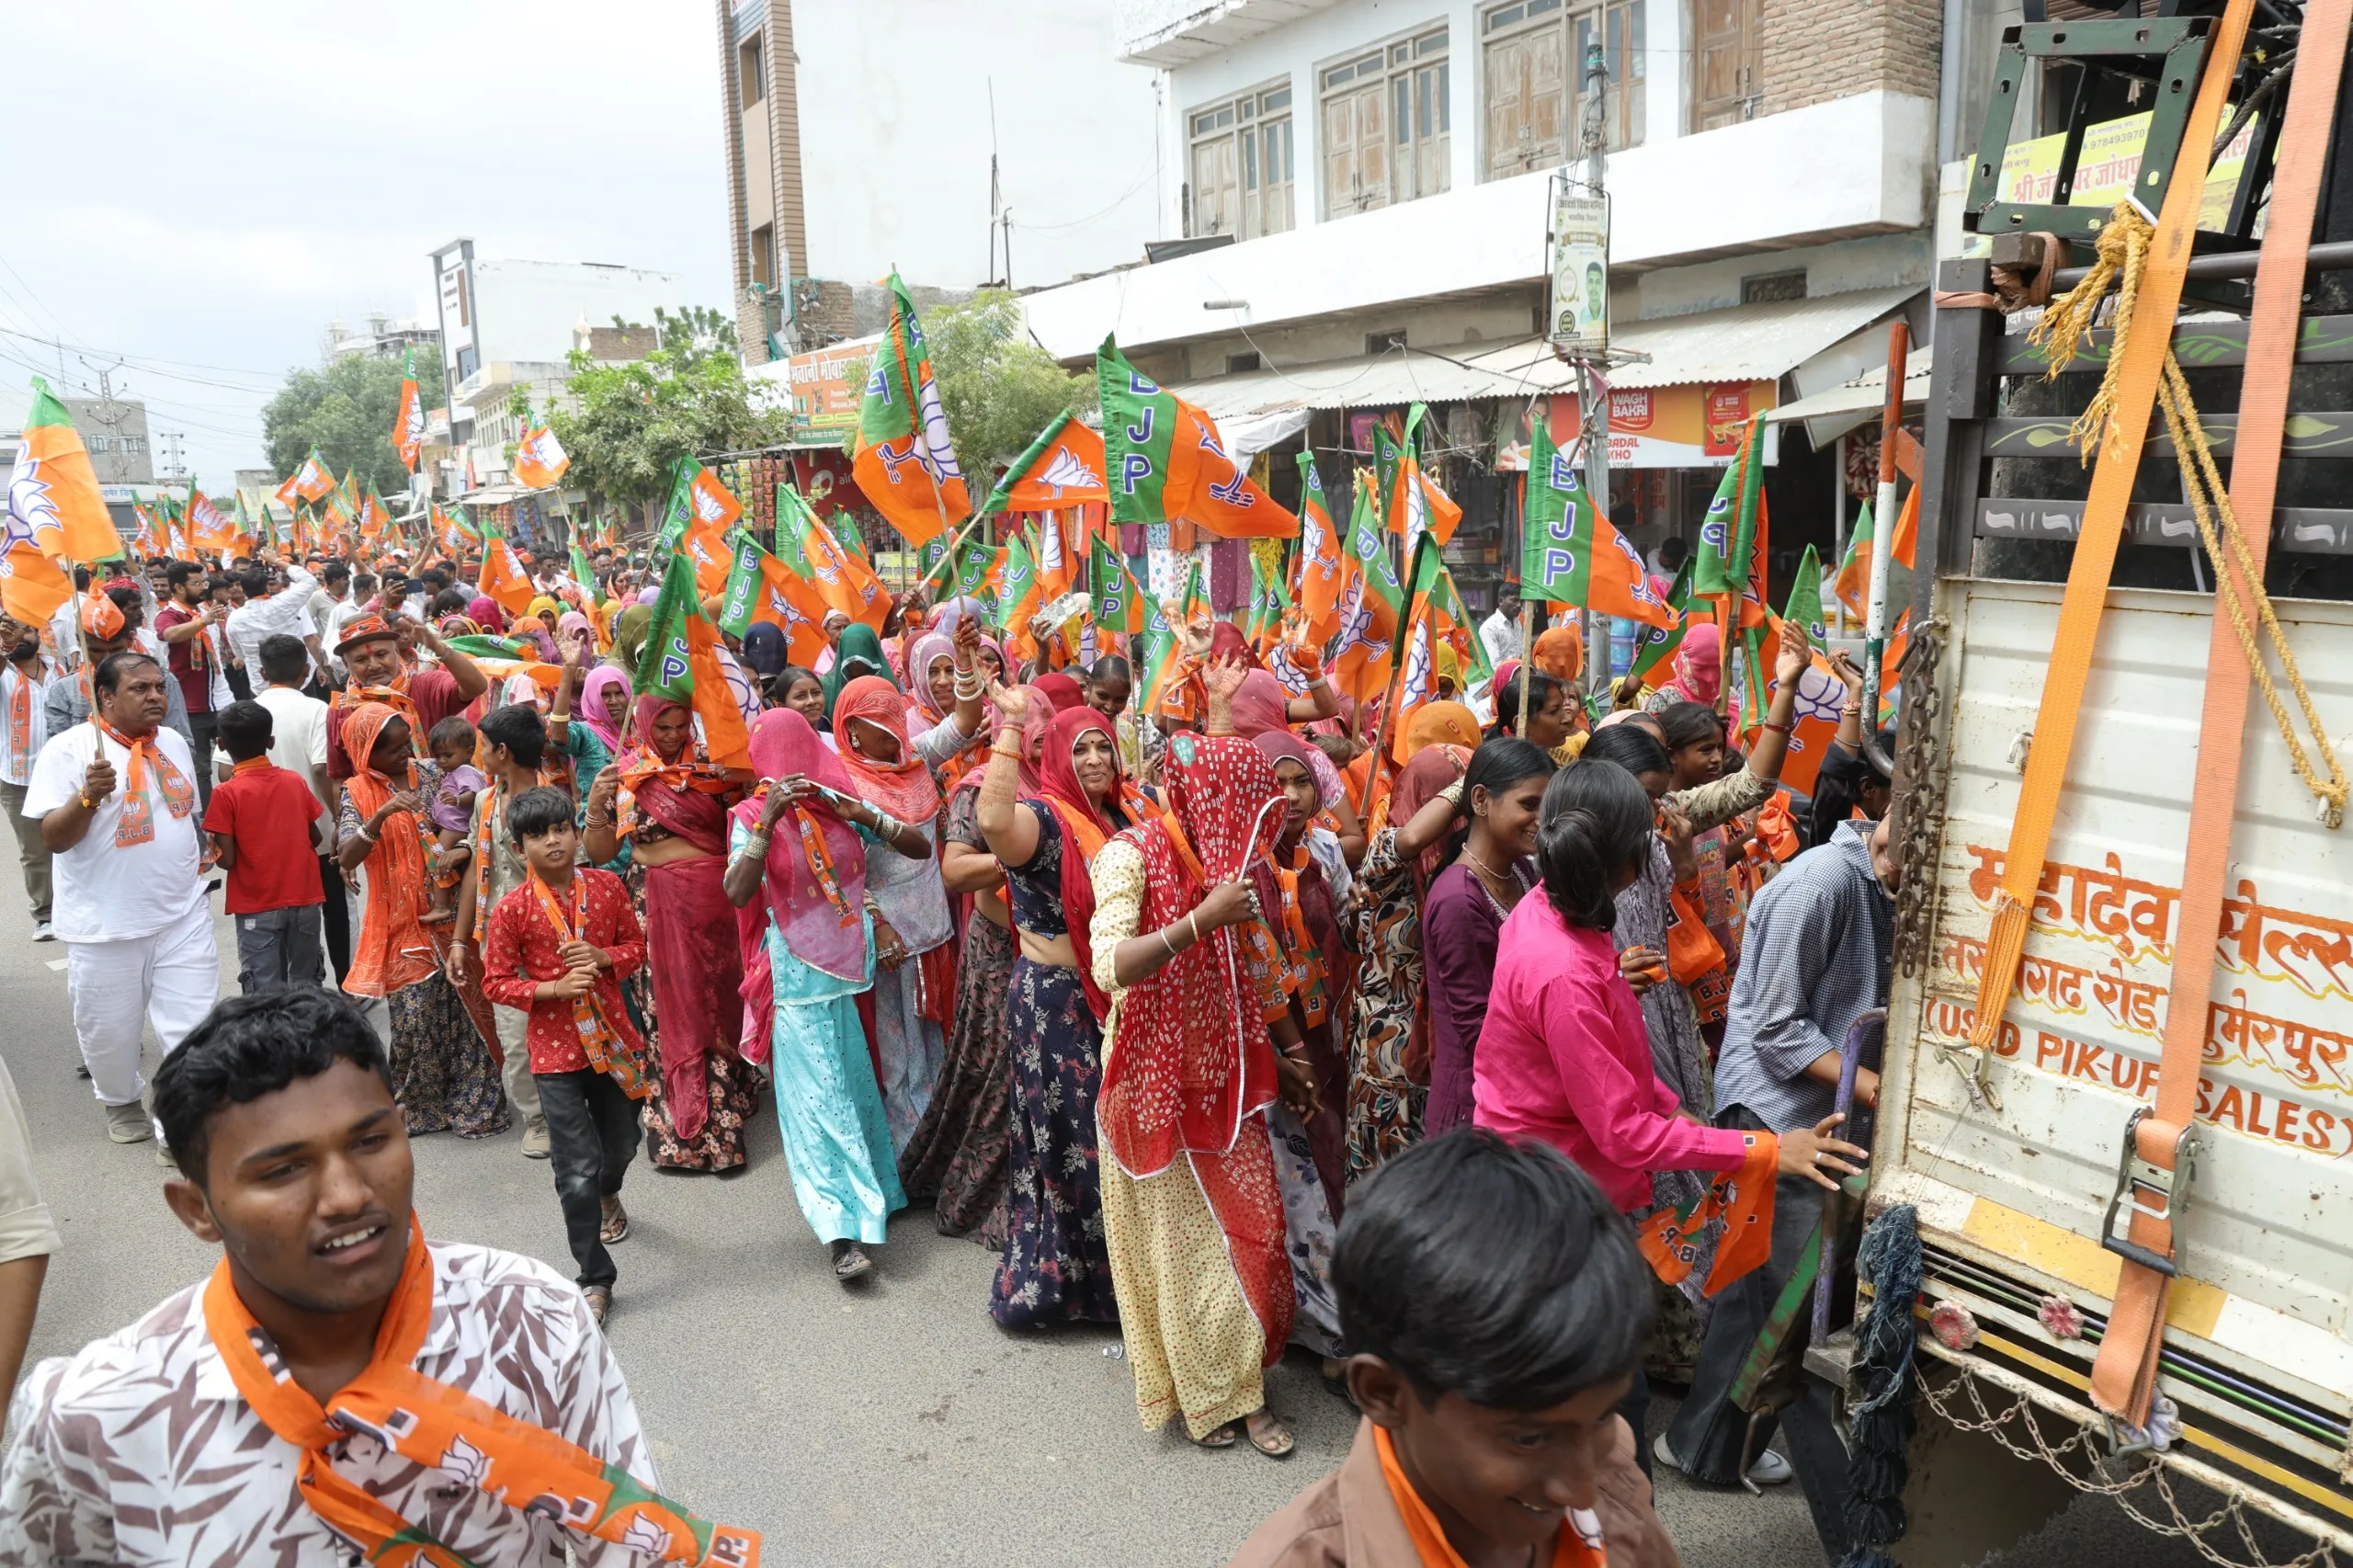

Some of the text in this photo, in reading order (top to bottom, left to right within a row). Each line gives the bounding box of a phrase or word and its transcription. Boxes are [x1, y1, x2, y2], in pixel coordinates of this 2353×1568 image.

[2013, 173, 2034, 203] श्री
[2095, 153, 2143, 189] जोधपु
[1611, 392, 1648, 405] WAGH
[1612, 404, 1648, 418] BAKRI
[1543, 453, 1579, 586] BJP
[726, 545, 760, 623] BJP
[2092, 957, 2169, 1030] रोड
[2202, 987, 2353, 1086] ुमेरपुर
[1926, 995, 2021, 1057] (USD
[2195, 1077, 2353, 1161] SALES)
